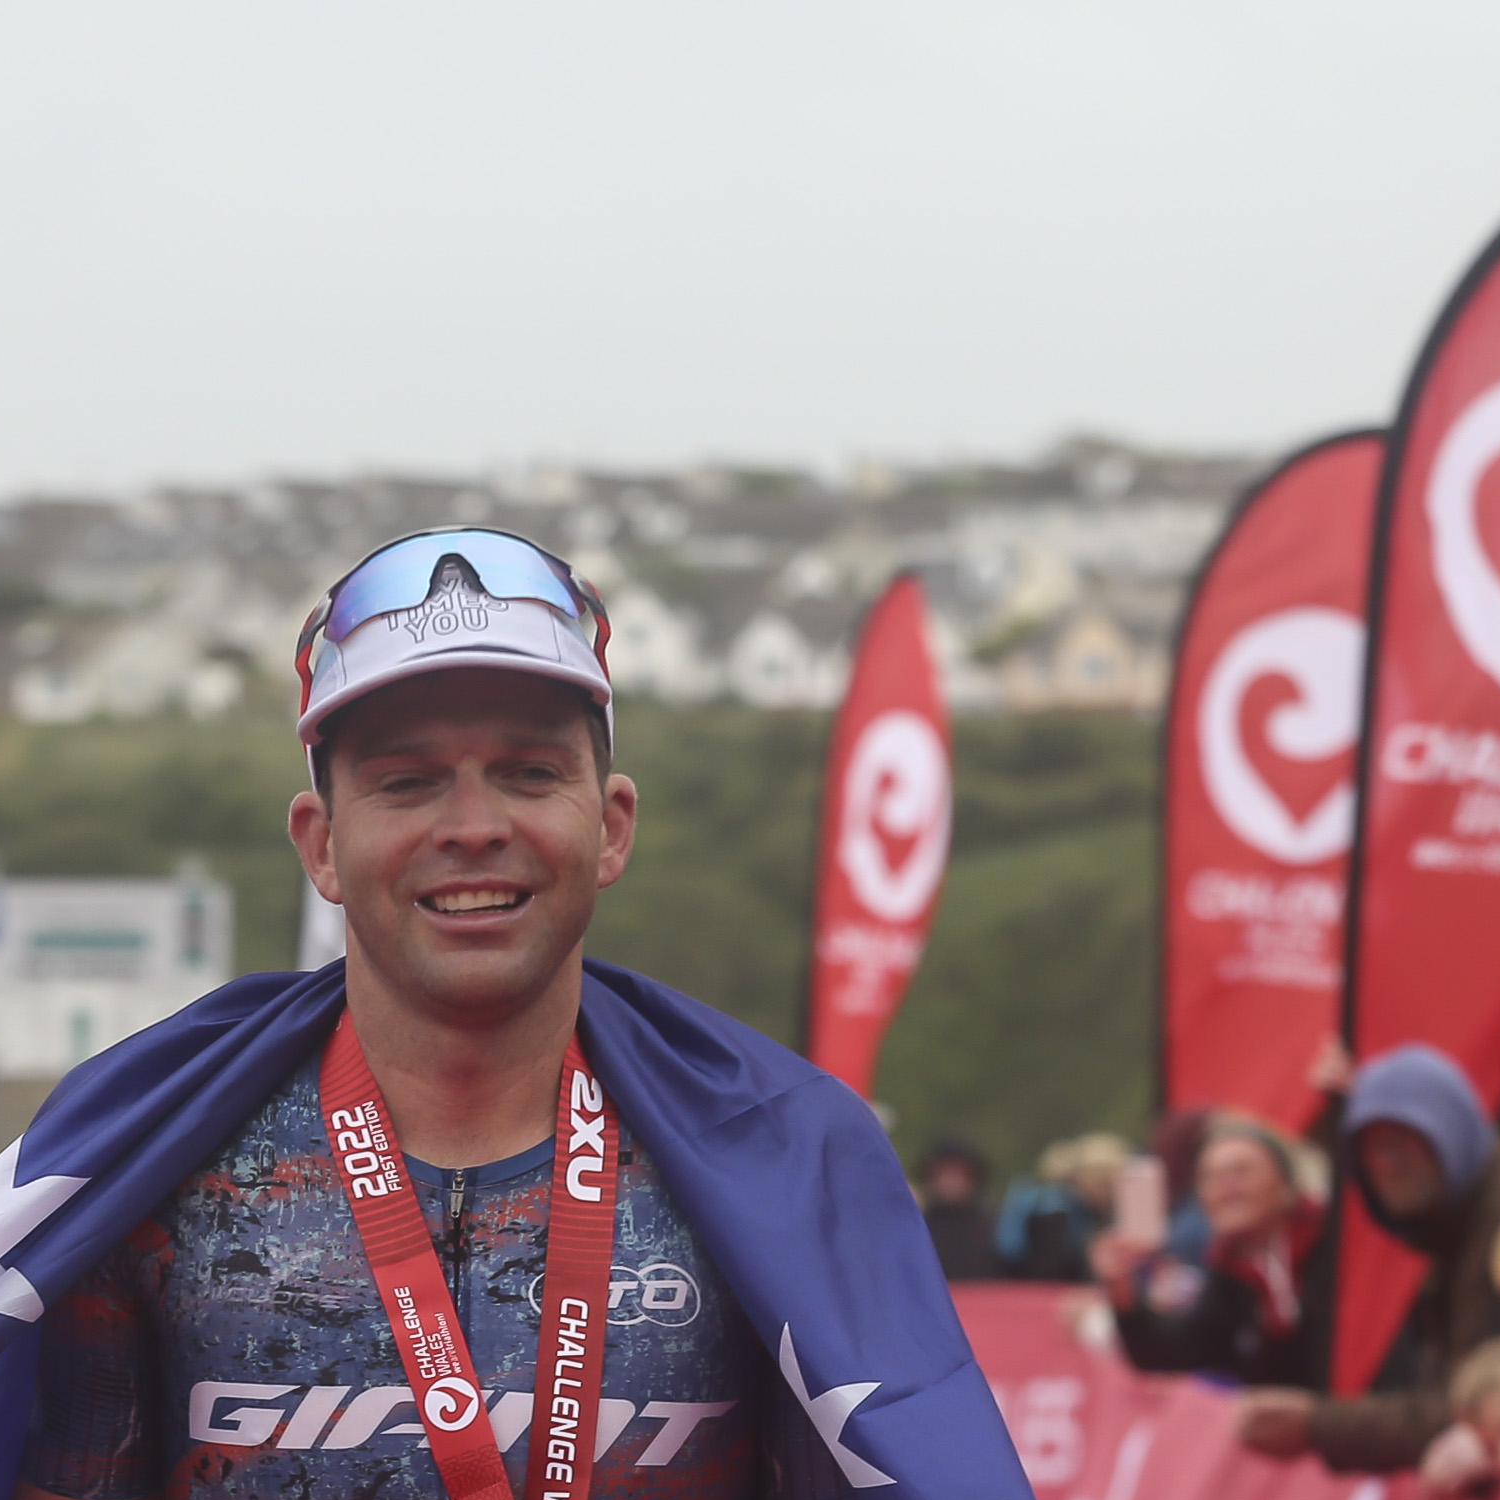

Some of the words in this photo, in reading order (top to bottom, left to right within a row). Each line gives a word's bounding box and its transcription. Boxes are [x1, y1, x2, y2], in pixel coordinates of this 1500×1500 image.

[404, 608, 489, 644] YOU
[331, 1105, 389, 1199] 2022
[361, 1100, 389, 1152] EDITION
[564, 1068, 604, 1203] 2XU
[379, 1154, 402, 1192] FIRST
[393, 1286, 437, 1379] CHALLENGE
[426, 1333, 453, 1377] WALES
[545, 1296, 589, 1485] CHALLENGE
